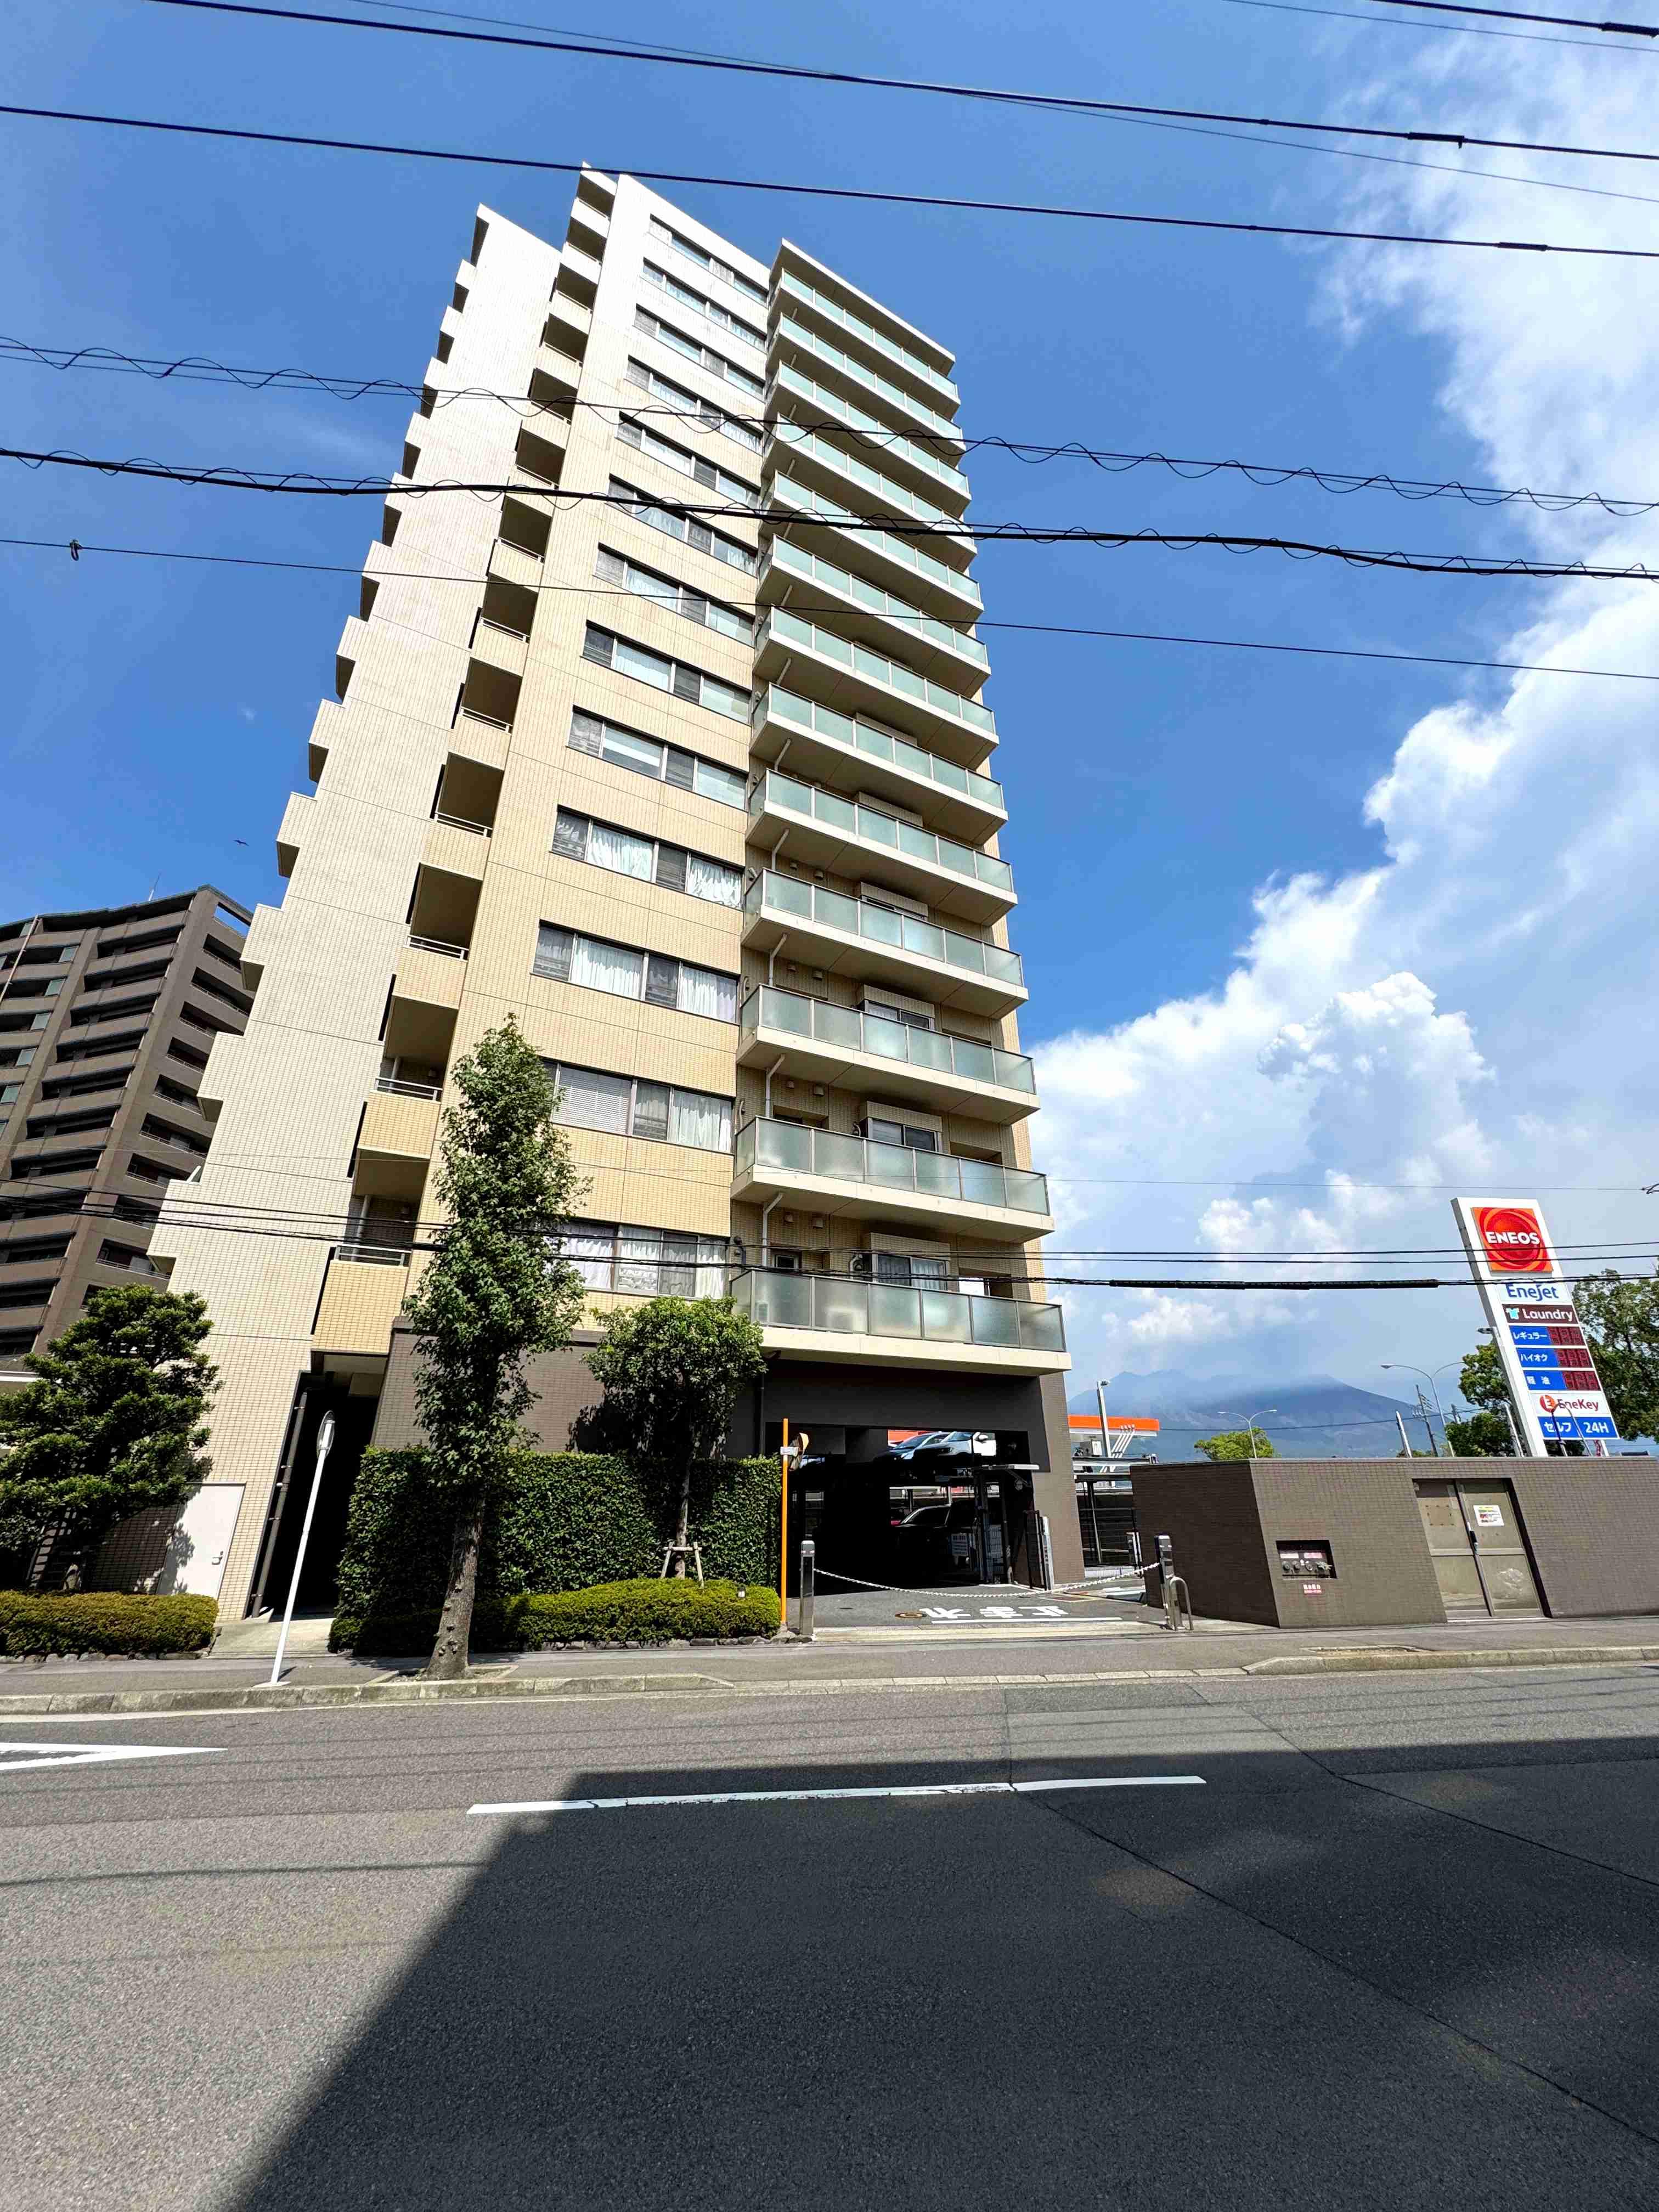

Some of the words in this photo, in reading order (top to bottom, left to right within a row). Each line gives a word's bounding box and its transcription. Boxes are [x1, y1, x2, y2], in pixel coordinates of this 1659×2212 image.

[1486, 1231, 1540, 1245] ENEOS
[1505, 1283, 1559, 1301] Enejet
[1522, 1308, 1573, 1322] Laundry
[1513, 1331, 1548, 1340] レギュラー
[1520, 1353, 1548, 1362] ハイオク
[1556, 1399, 1598, 1412] EneKey
[1583, 1421, 1610, 1433] 24H
